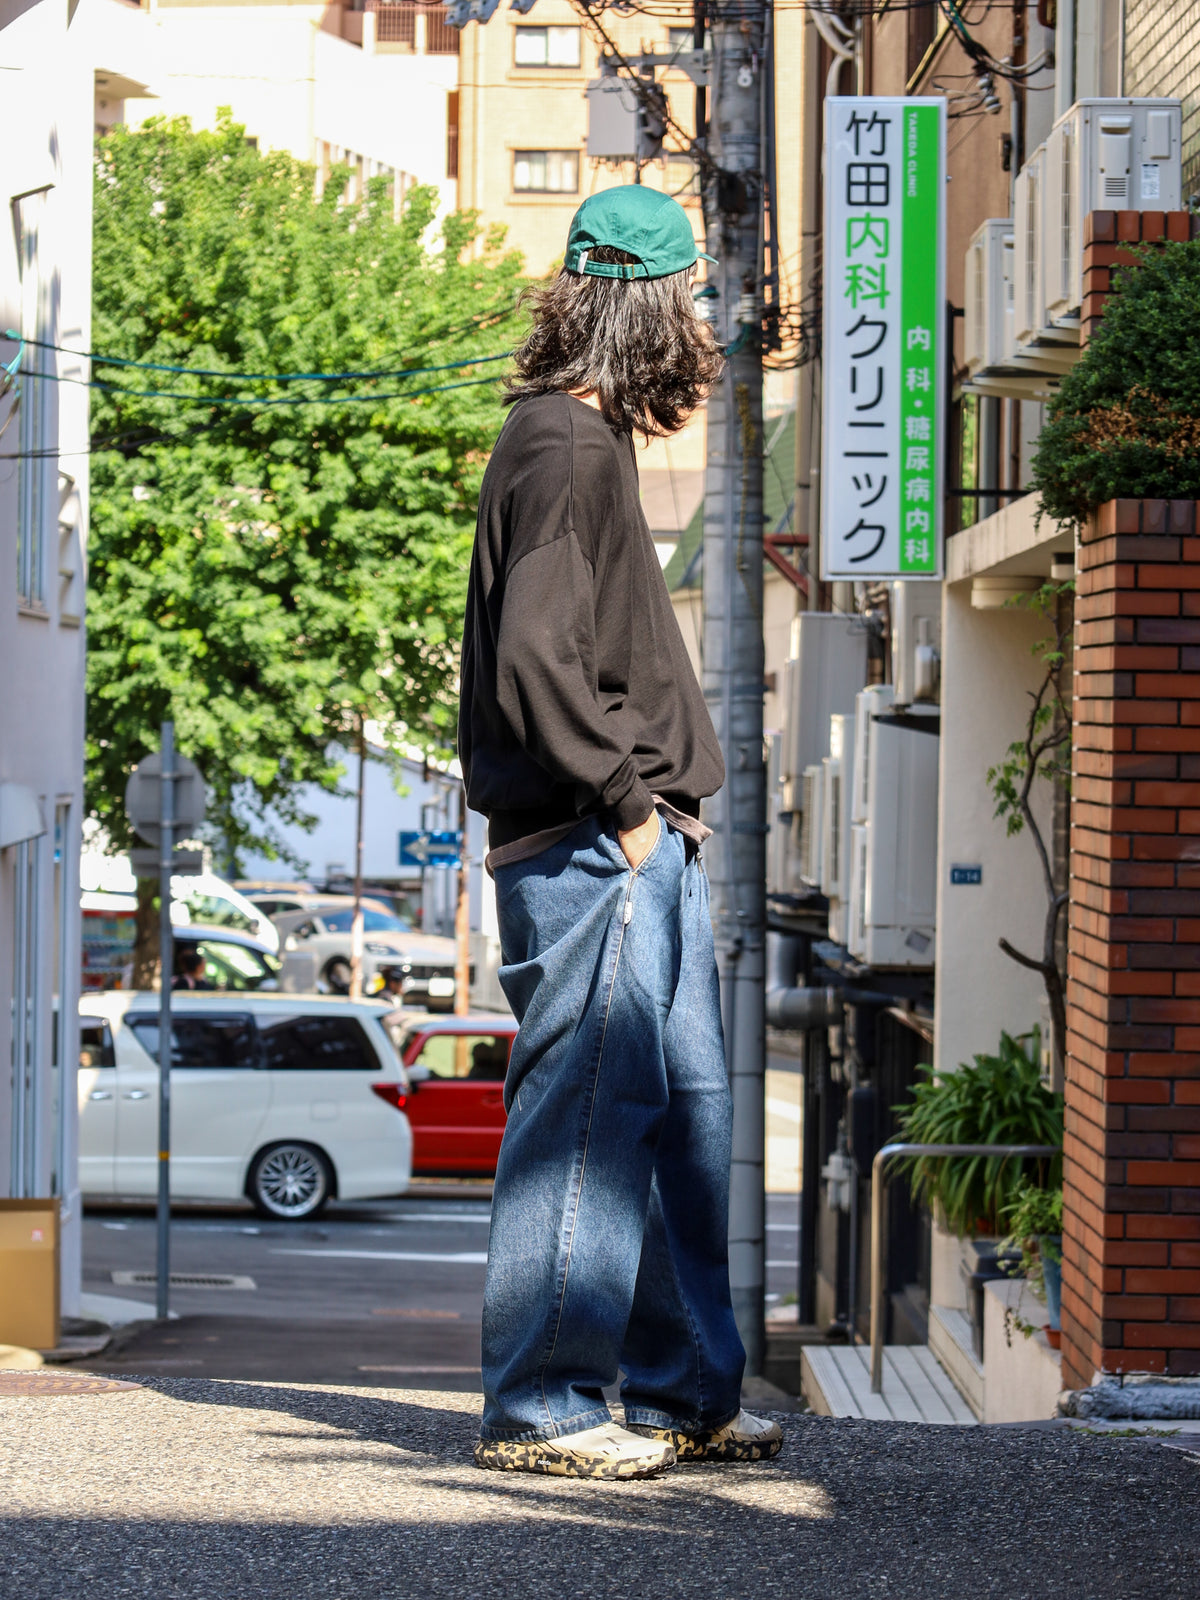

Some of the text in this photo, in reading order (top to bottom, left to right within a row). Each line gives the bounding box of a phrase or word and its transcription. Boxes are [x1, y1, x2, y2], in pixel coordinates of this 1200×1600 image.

[906, 111, 919, 198] TAKEDA CLINIC
[843, 109, 892, 564] 竹田内科クリニック
[904, 325, 932, 564] 内科・糖尿病内科
